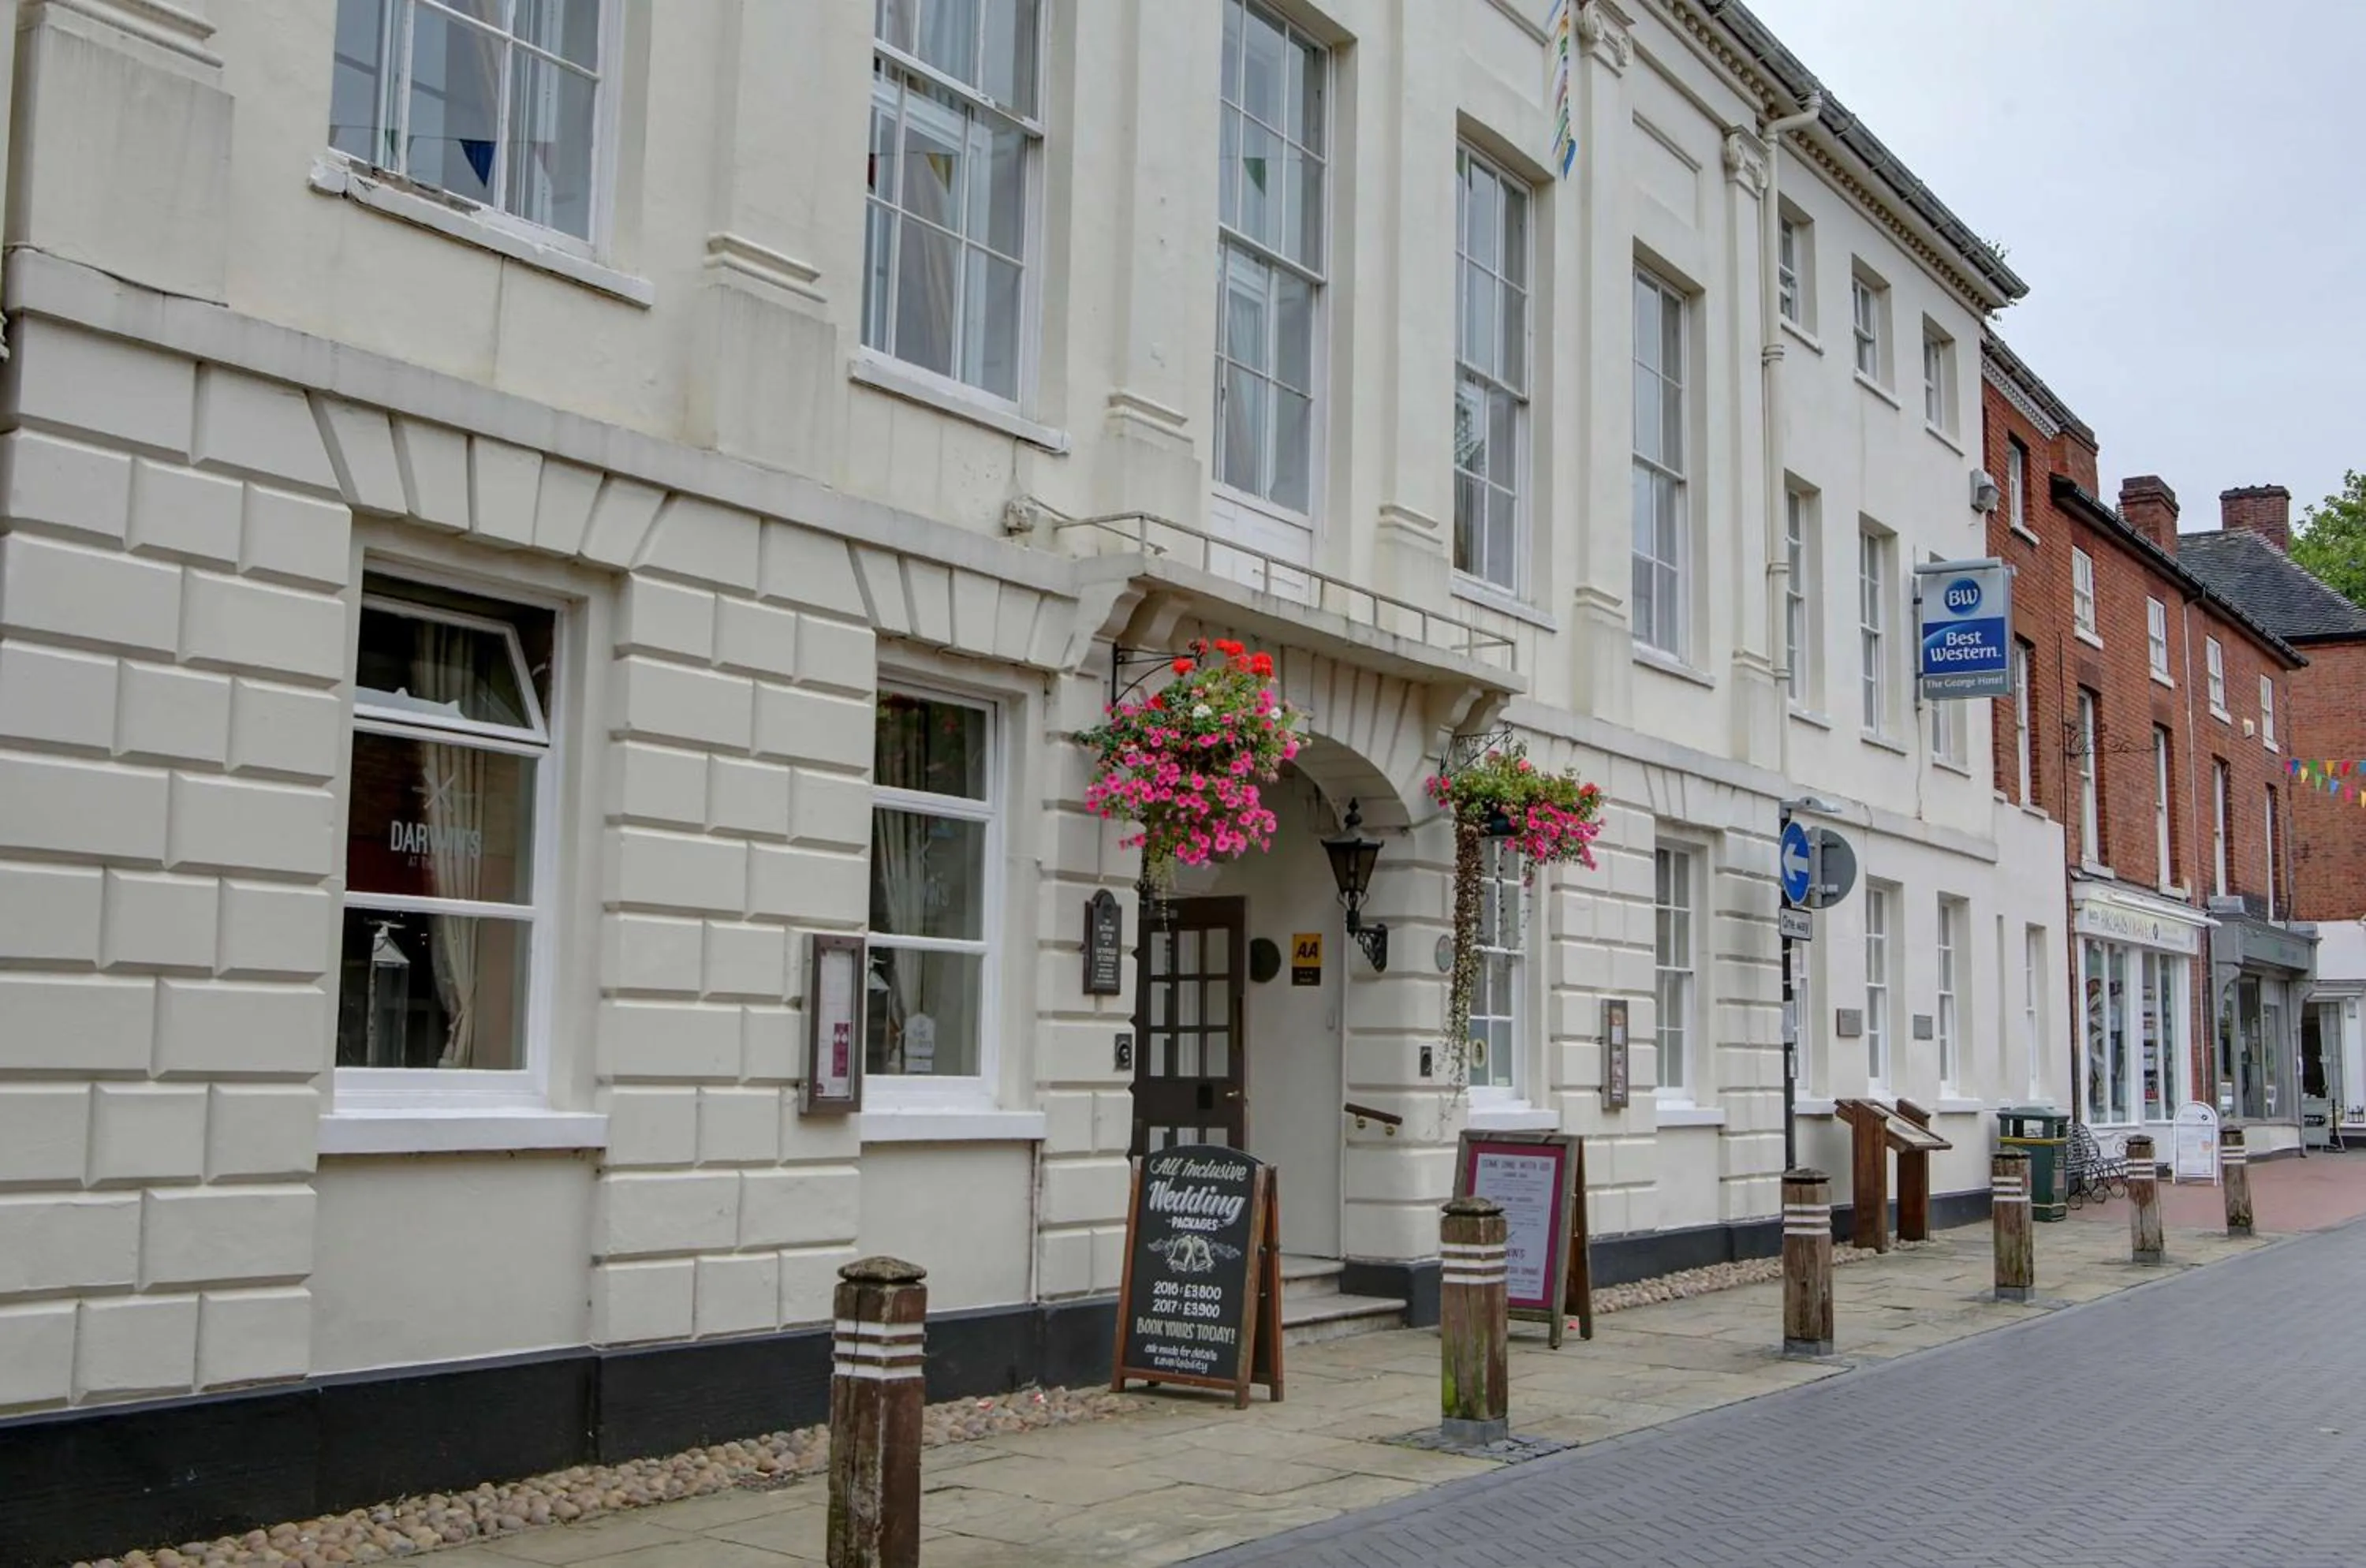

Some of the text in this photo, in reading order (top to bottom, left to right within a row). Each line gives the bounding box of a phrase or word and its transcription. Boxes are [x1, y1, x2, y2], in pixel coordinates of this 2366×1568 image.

[1948, 589, 1978, 607] BW
[1946, 631, 1981, 646] Best
[1926, 680, 1942, 689] The
[1296, 941, 1318, 958] AA
[1149, 1157, 1248, 1182] All Inclusive
[1148, 1177, 1246, 1226] Wedding
[1183, 1301, 1220, 1318] £3900
[1136, 1316, 1236, 1345] BOOK YOURS TODAY!
